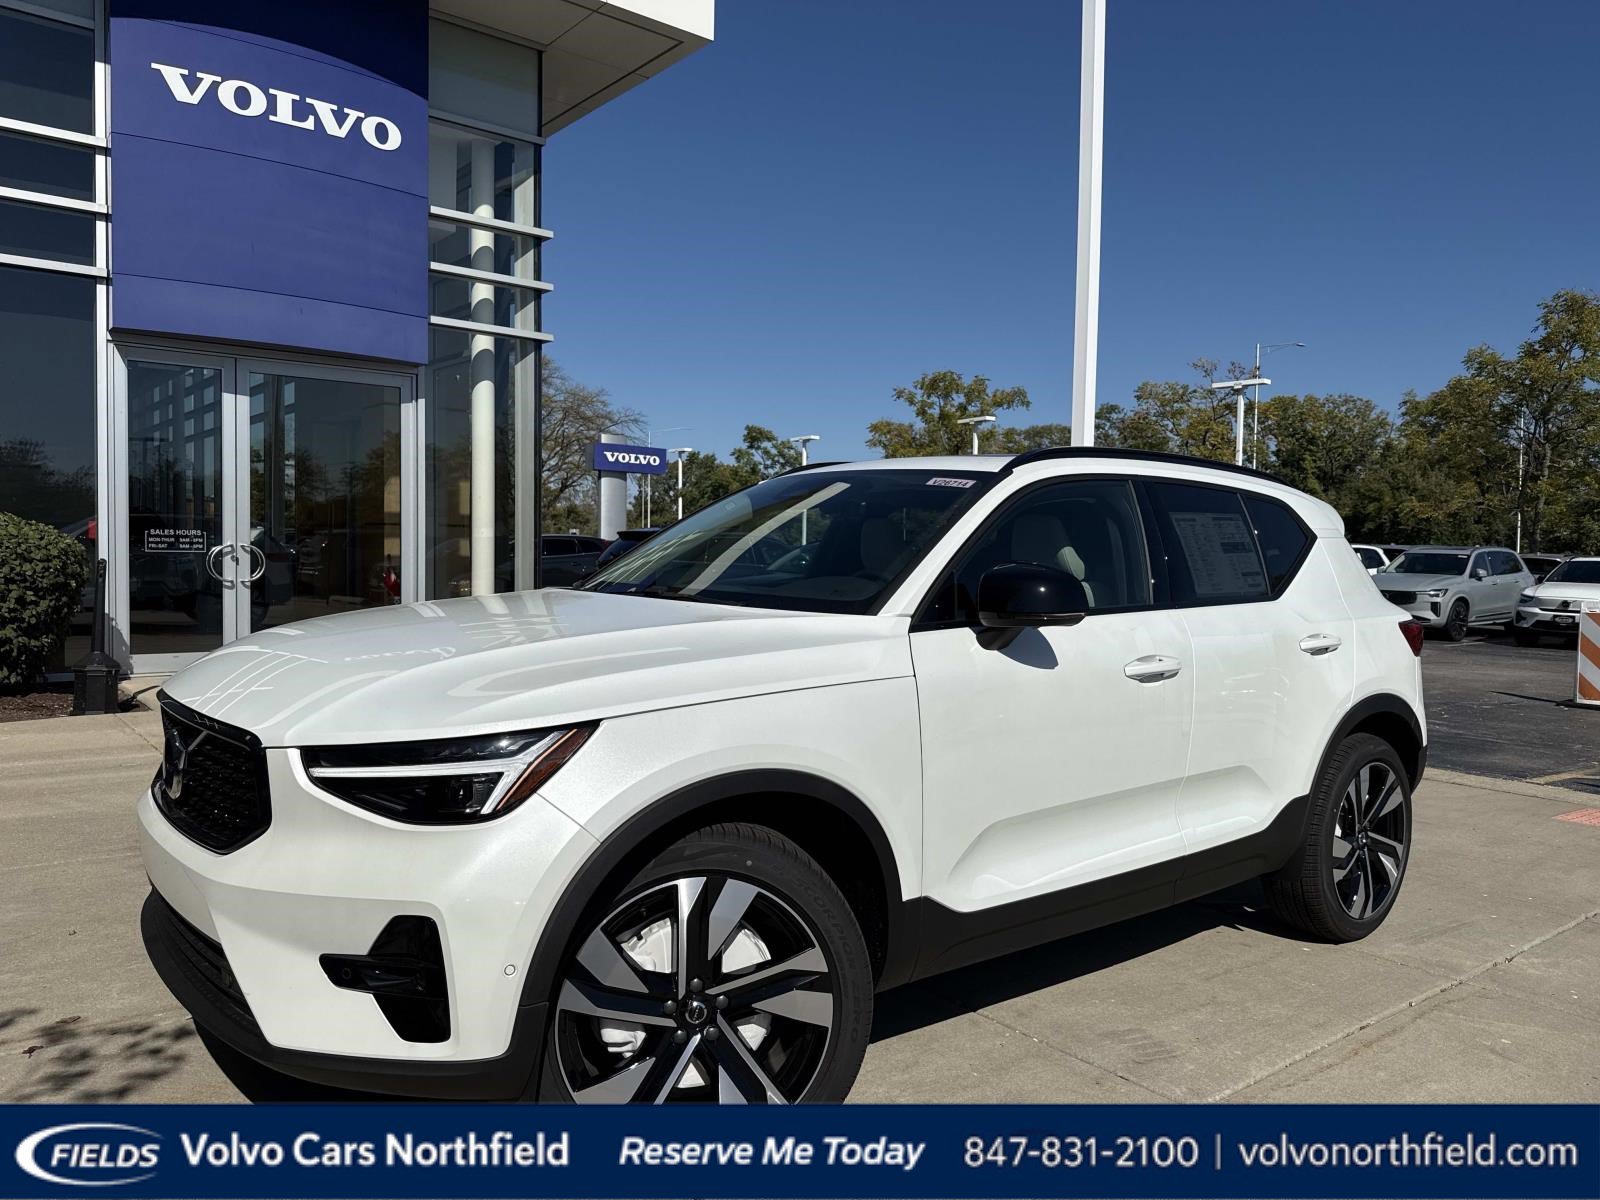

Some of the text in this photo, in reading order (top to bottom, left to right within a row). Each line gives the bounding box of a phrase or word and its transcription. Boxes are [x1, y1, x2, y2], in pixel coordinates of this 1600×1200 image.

[151, 62, 403, 152] VOLVO
[603, 451, 661, 466] VOLVO
[150, 528, 174, 536] SALES
